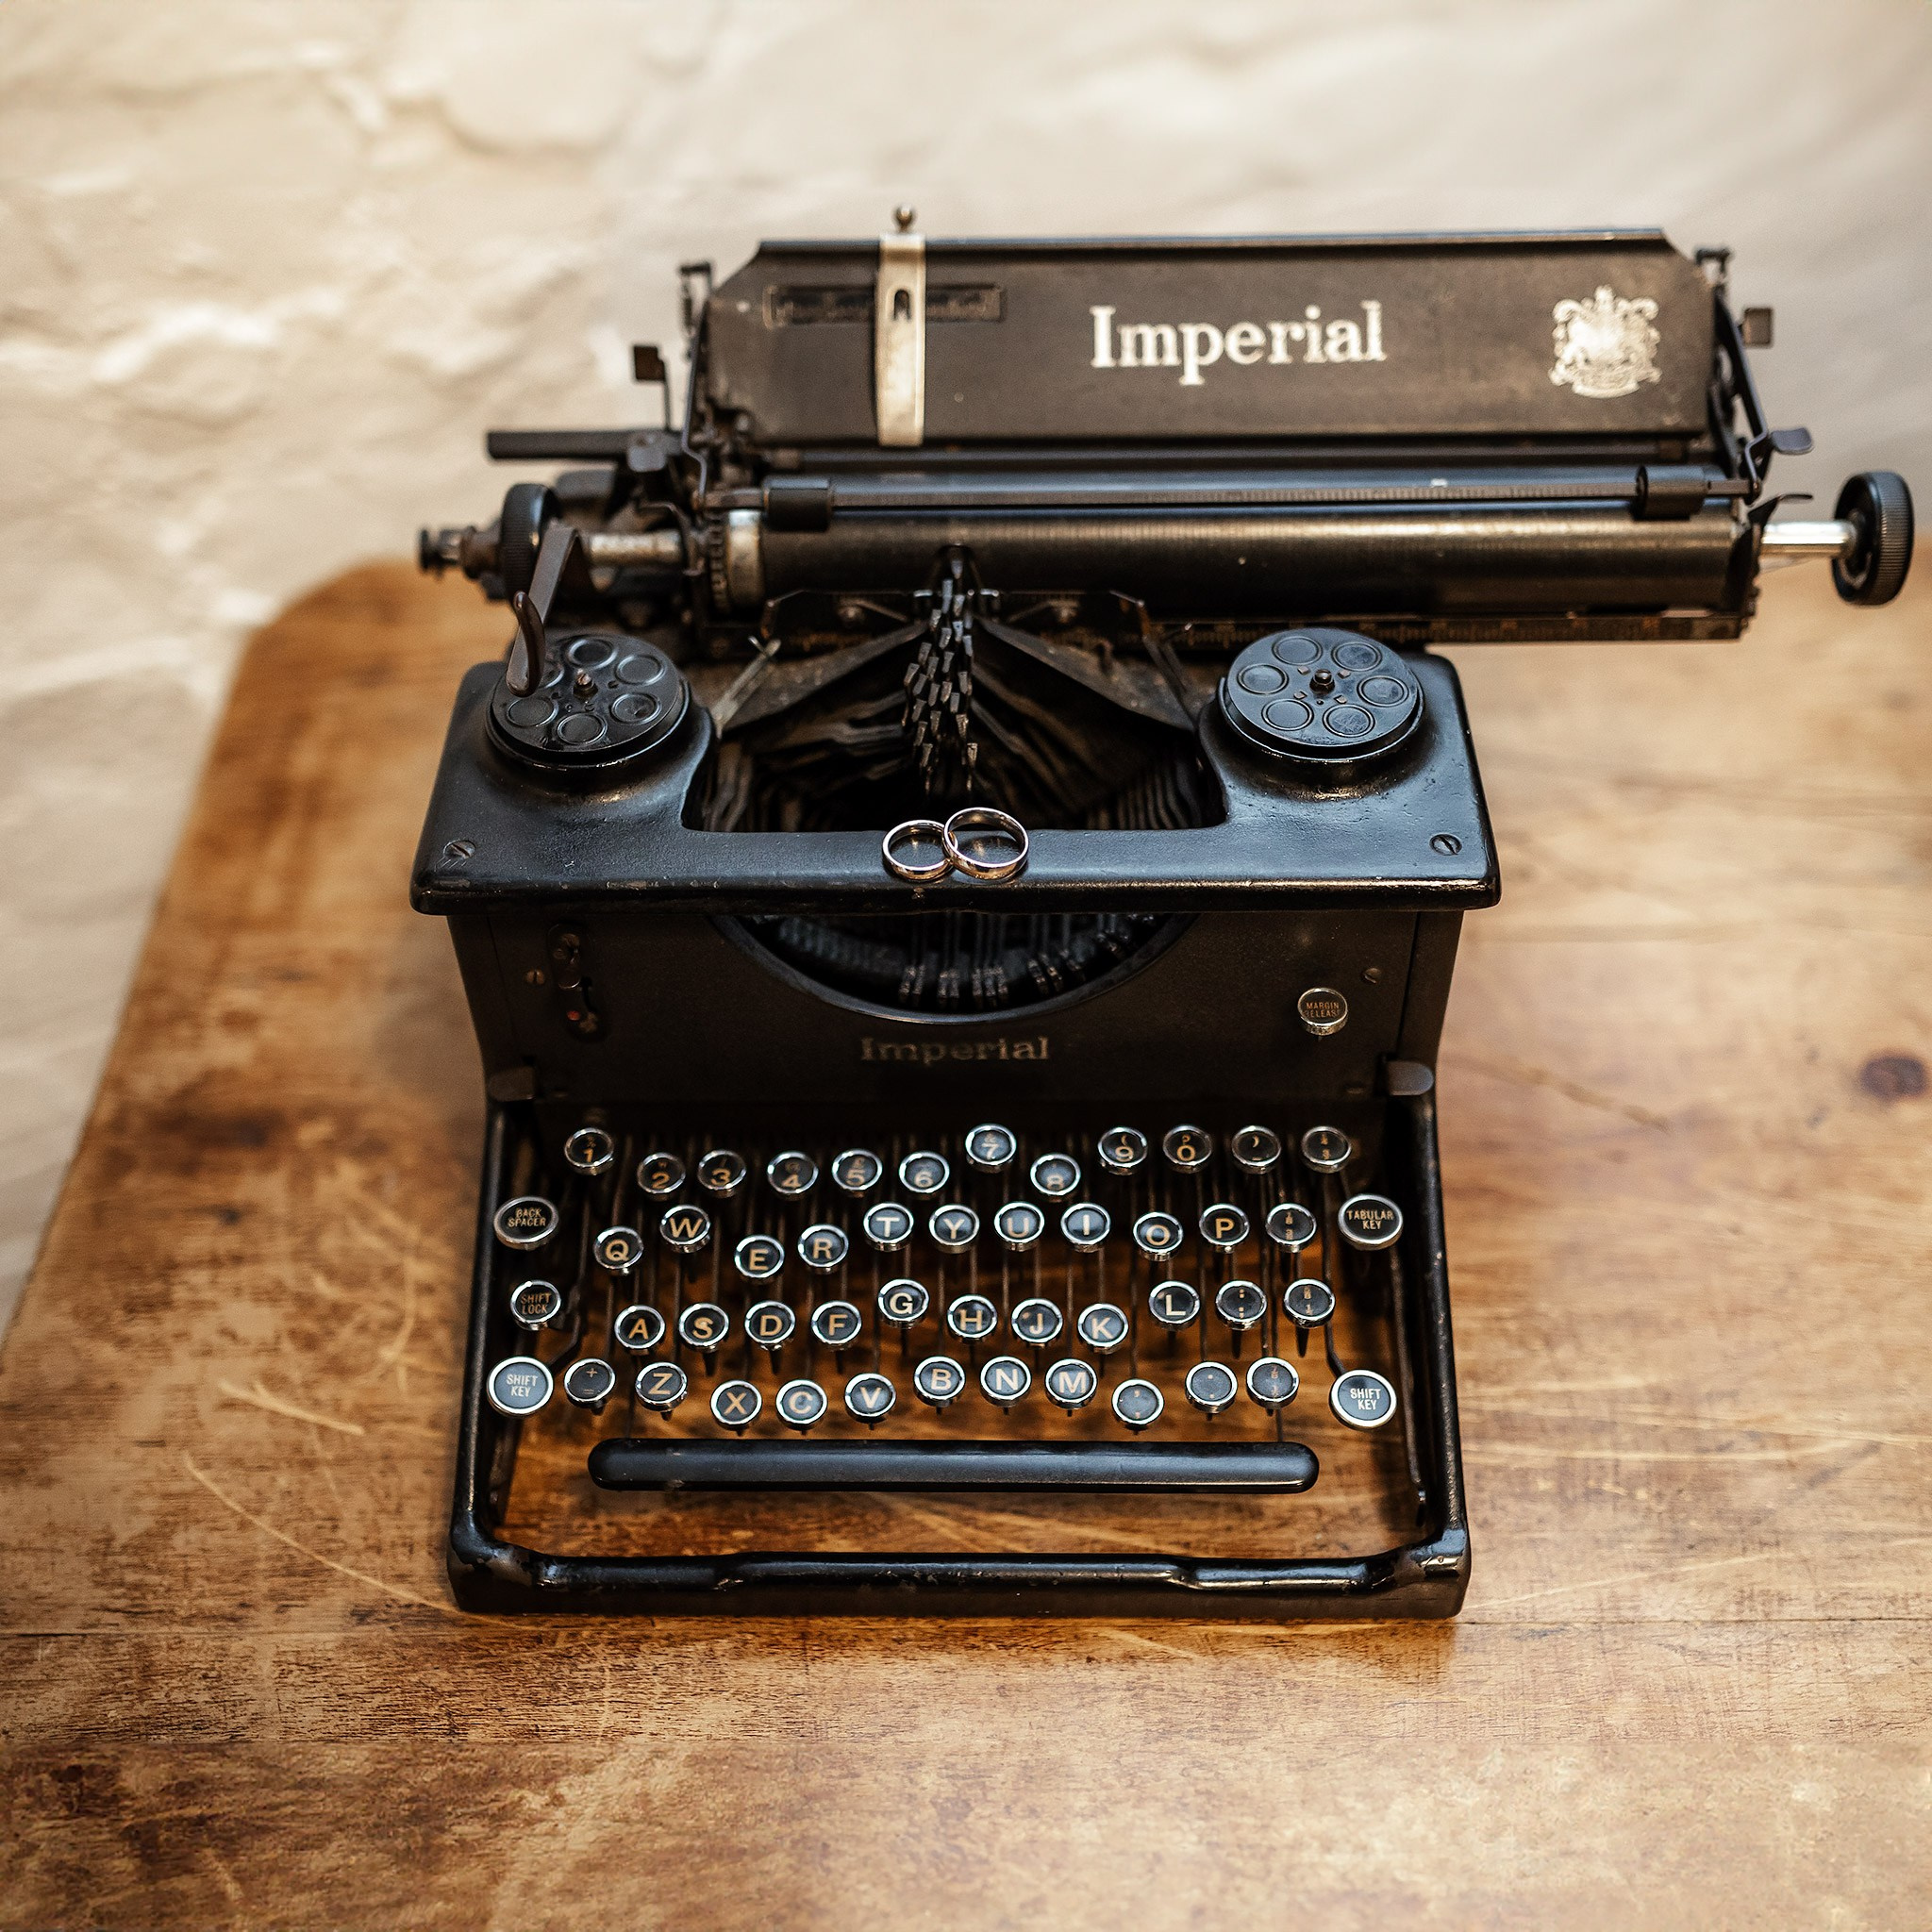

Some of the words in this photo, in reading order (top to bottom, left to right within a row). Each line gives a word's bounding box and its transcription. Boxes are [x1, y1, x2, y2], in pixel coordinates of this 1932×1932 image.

[1090, 299, 1388, 386] Imperial
[1306, 1002, 1340, 1010] MARGIN
[860, 1037, 1050, 1067] Imperial
[583, 1148, 593, 1162] 1
[981, 1142, 999, 1159] 7
[1115, 1145, 1134, 1161] 9
[652, 1171, 670, 1189] 2
[711, 1168, 730, 1186] 3
[783, 1174, 801, 1189] 4
[847, 1169, 864, 1187] 5
[915, 1171, 934, 1188] 6
[1046, 1174, 1064, 1191] 8
[508, 1216, 546, 1227] SPACER
[516, 1208, 542, 1218] BACK
[1346, 1209, 1394, 1221] TABULAR
[669, 1218, 703, 1239] W
[876, 1217, 900, 1237] T
[943, 1218, 965, 1240] Y
[1007, 1217, 1029, 1238] U
[1146, 1224, 1170, 1246] O
[1215, 1218, 1235, 1240] P
[1362, 1219, 1382, 1230] KEY
[606, 1240, 629, 1262] Q
[813, 1238, 832, 1259] R
[749, 1248, 768, 1271] E
[521, 1292, 551, 1305] SHIFT
[522, 1303, 548, 1315] LOCK
[890, 1292, 913, 1314] G
[1165, 1294, 1187, 1316] L
[628, 1319, 649, 1341] A
[692, 1317, 714, 1339] S
[759, 1314, 783, 1337] D
[828, 1314, 848, 1336] F
[959, 1309, 983, 1331] H
[1029, 1313, 1043, 1335] J
[1091, 1317, 1113, 1340] K
[507, 1374, 538, 1386] SHIFT
[648, 1373, 672, 1395] Z
[930, 1369, 951, 1391] B
[995, 1368, 1018, 1391] N
[1058, 1372, 1086, 1393] M
[511, 1385, 531, 1397] KEY
[860, 1387, 881, 1408] V
[1350, 1388, 1381, 1400] SHIFT
[724, 1391, 747, 1415] X
[790, 1391, 813, 1414] C
[1357, 1399, 1377, 1410] KEY
